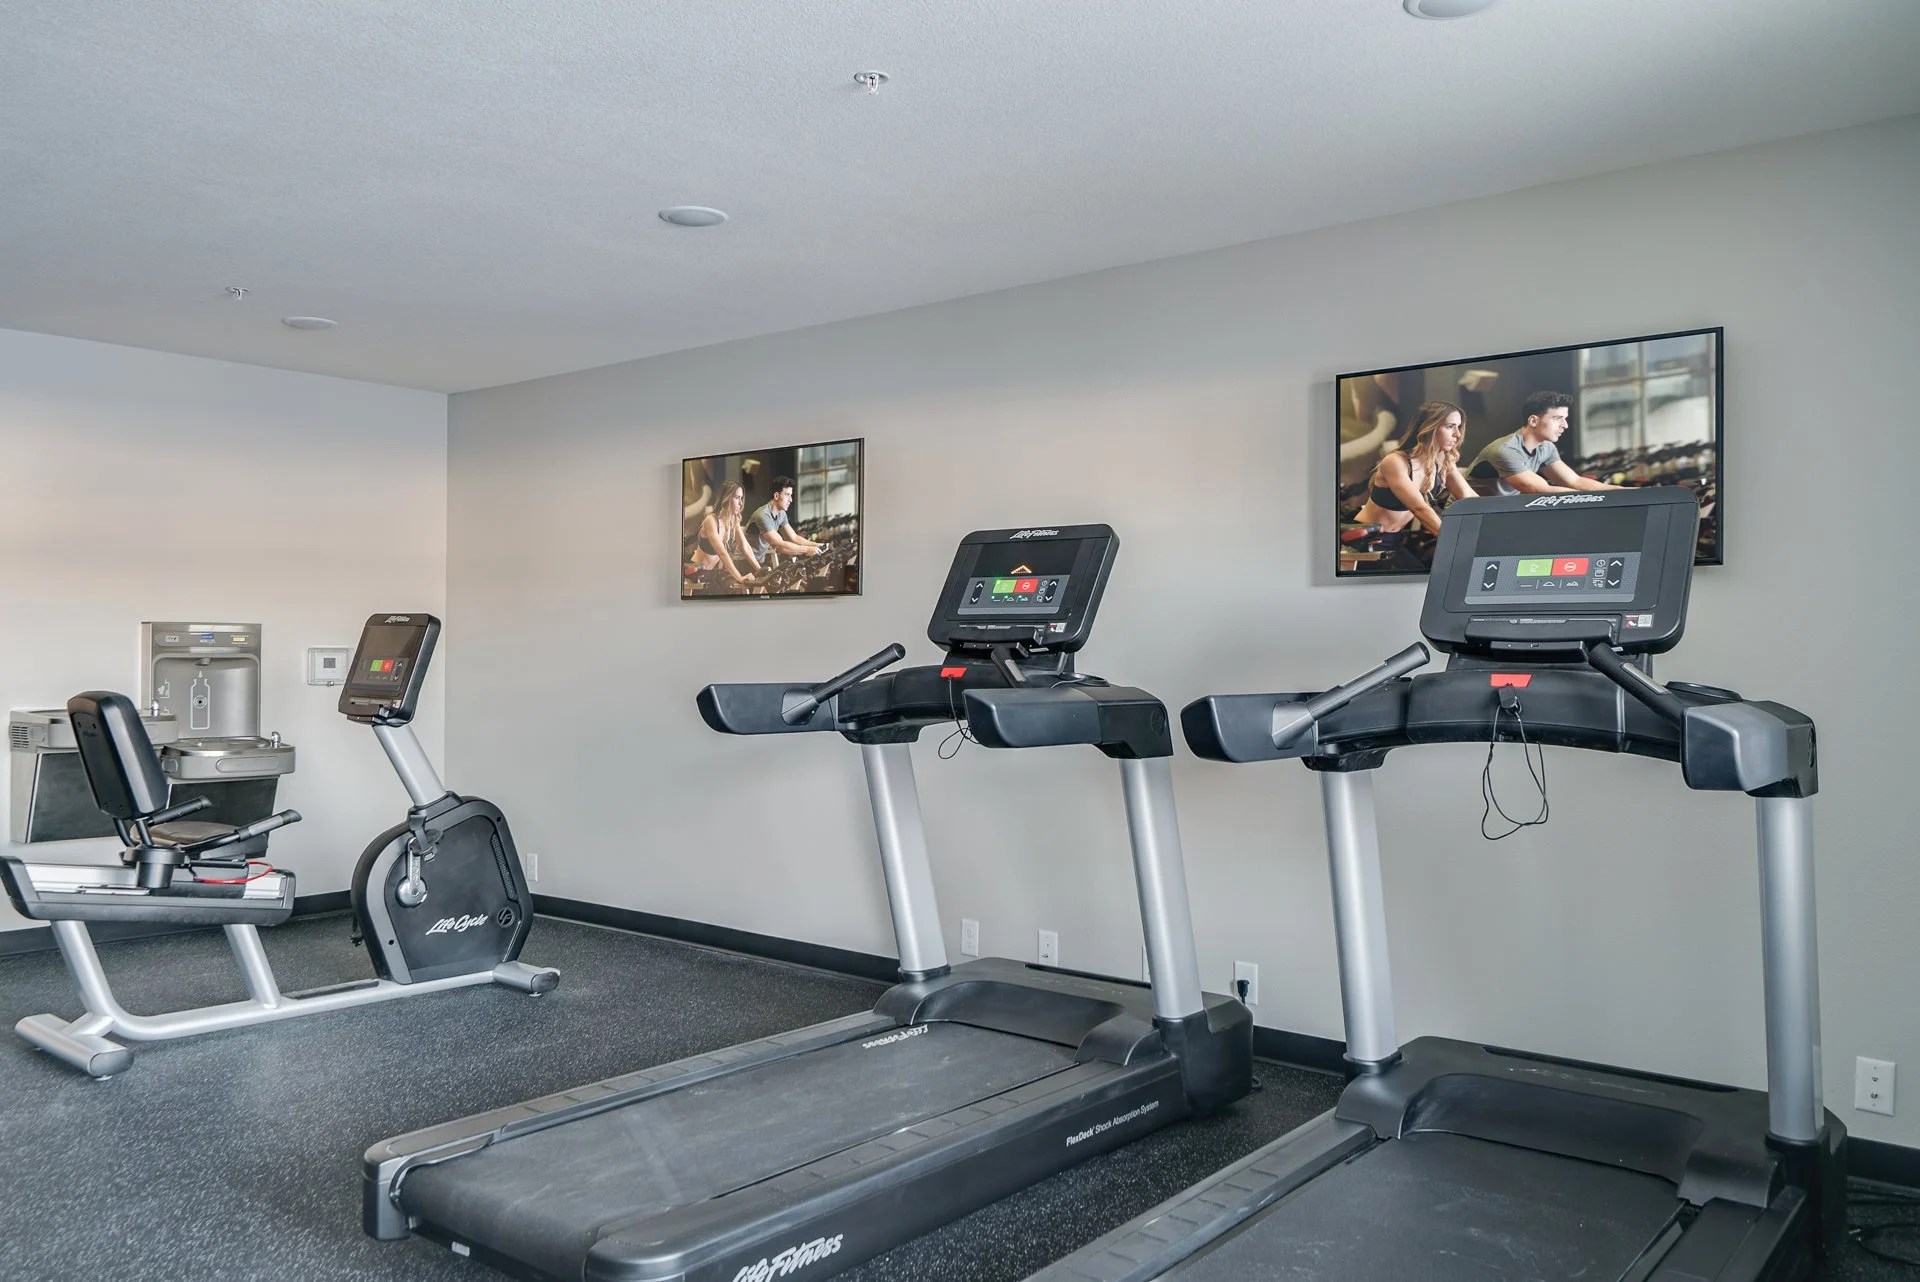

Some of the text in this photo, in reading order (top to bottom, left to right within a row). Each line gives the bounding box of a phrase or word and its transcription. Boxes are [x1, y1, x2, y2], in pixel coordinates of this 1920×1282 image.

[1095, 1120, 1112, 1134] Shock
[1112, 1108, 1140, 1127] Absorption
[1140, 1100, 1159, 1115] System
